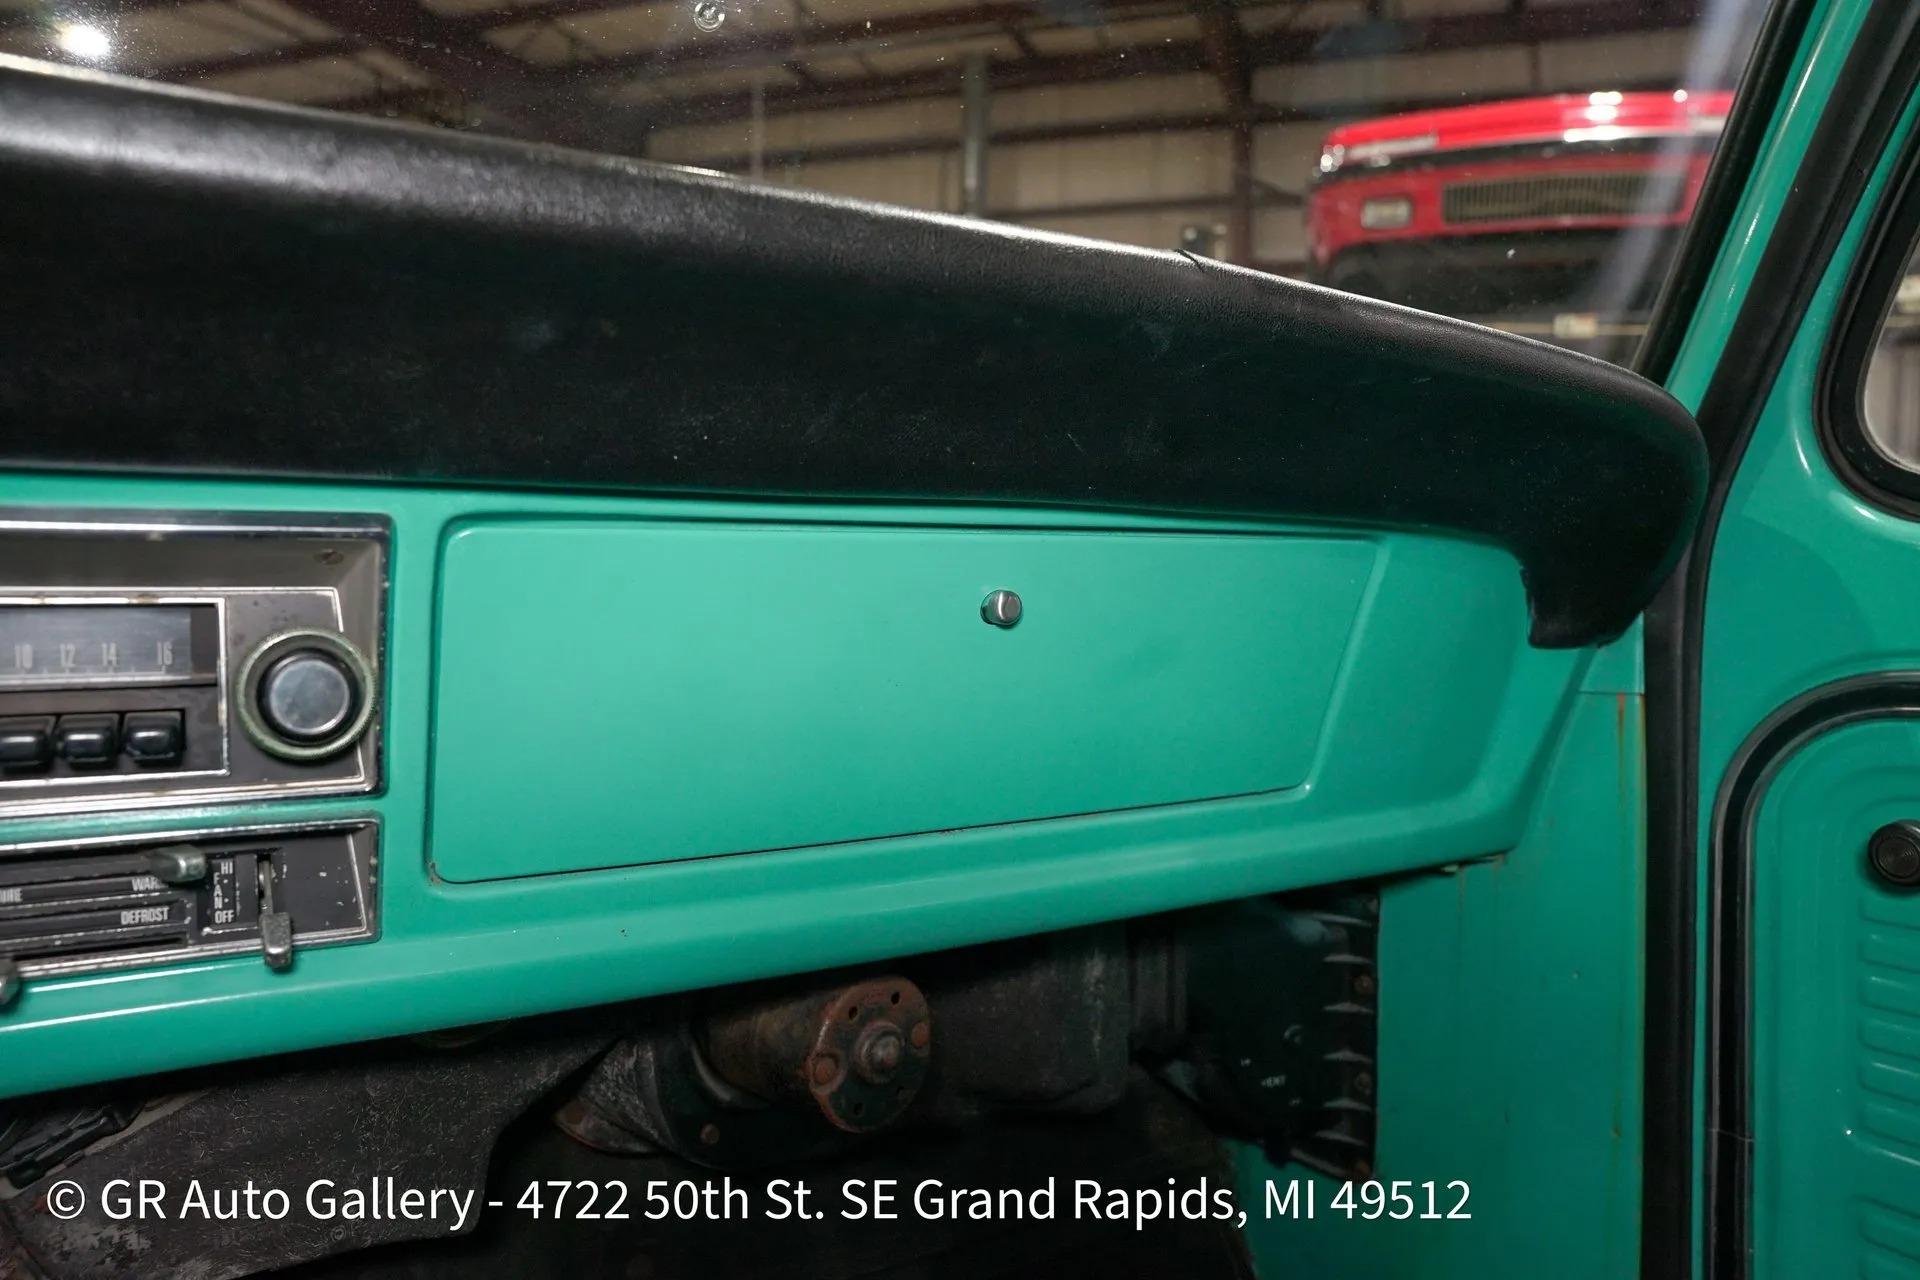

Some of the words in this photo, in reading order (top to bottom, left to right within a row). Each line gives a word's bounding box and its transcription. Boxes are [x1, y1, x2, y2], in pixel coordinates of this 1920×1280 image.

[14, 643, 34, 669] 10
[59, 643, 76, 668] 12
[101, 642, 118, 666] 14
[156, 641, 173, 665] 16
[220, 861, 233, 874] HI
[131, 876, 168, 891] WAR
[213, 872, 223, 909] FAN
[120, 906, 170, 925] DEFROST
[214, 909, 235, 923] OFF
